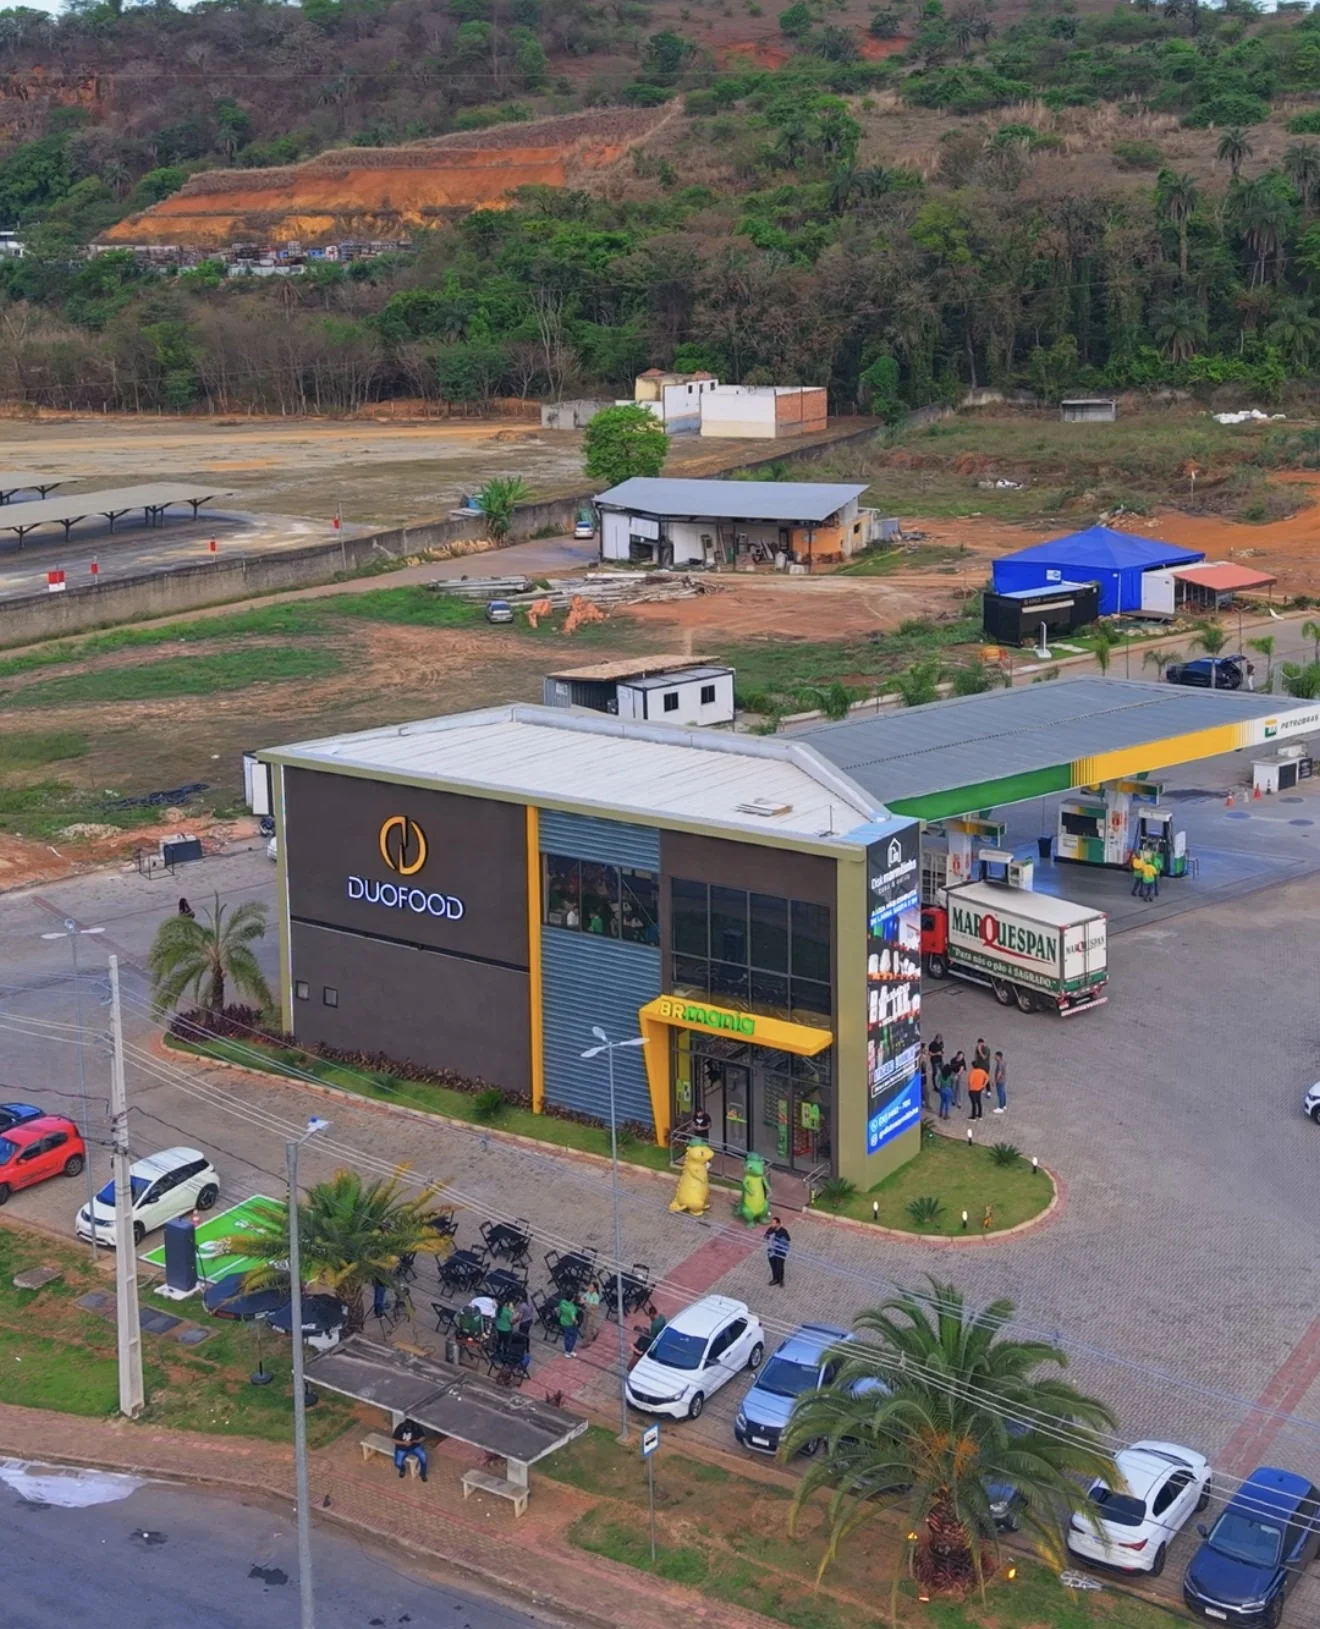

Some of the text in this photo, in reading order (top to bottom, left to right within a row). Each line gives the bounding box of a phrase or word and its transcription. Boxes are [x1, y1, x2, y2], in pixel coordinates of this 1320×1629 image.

[1281, 714, 1319, 729] PETROBRAS
[348, 876, 464, 920] DUOFOOD
[952, 907, 1057, 963] MARQUESPAN
